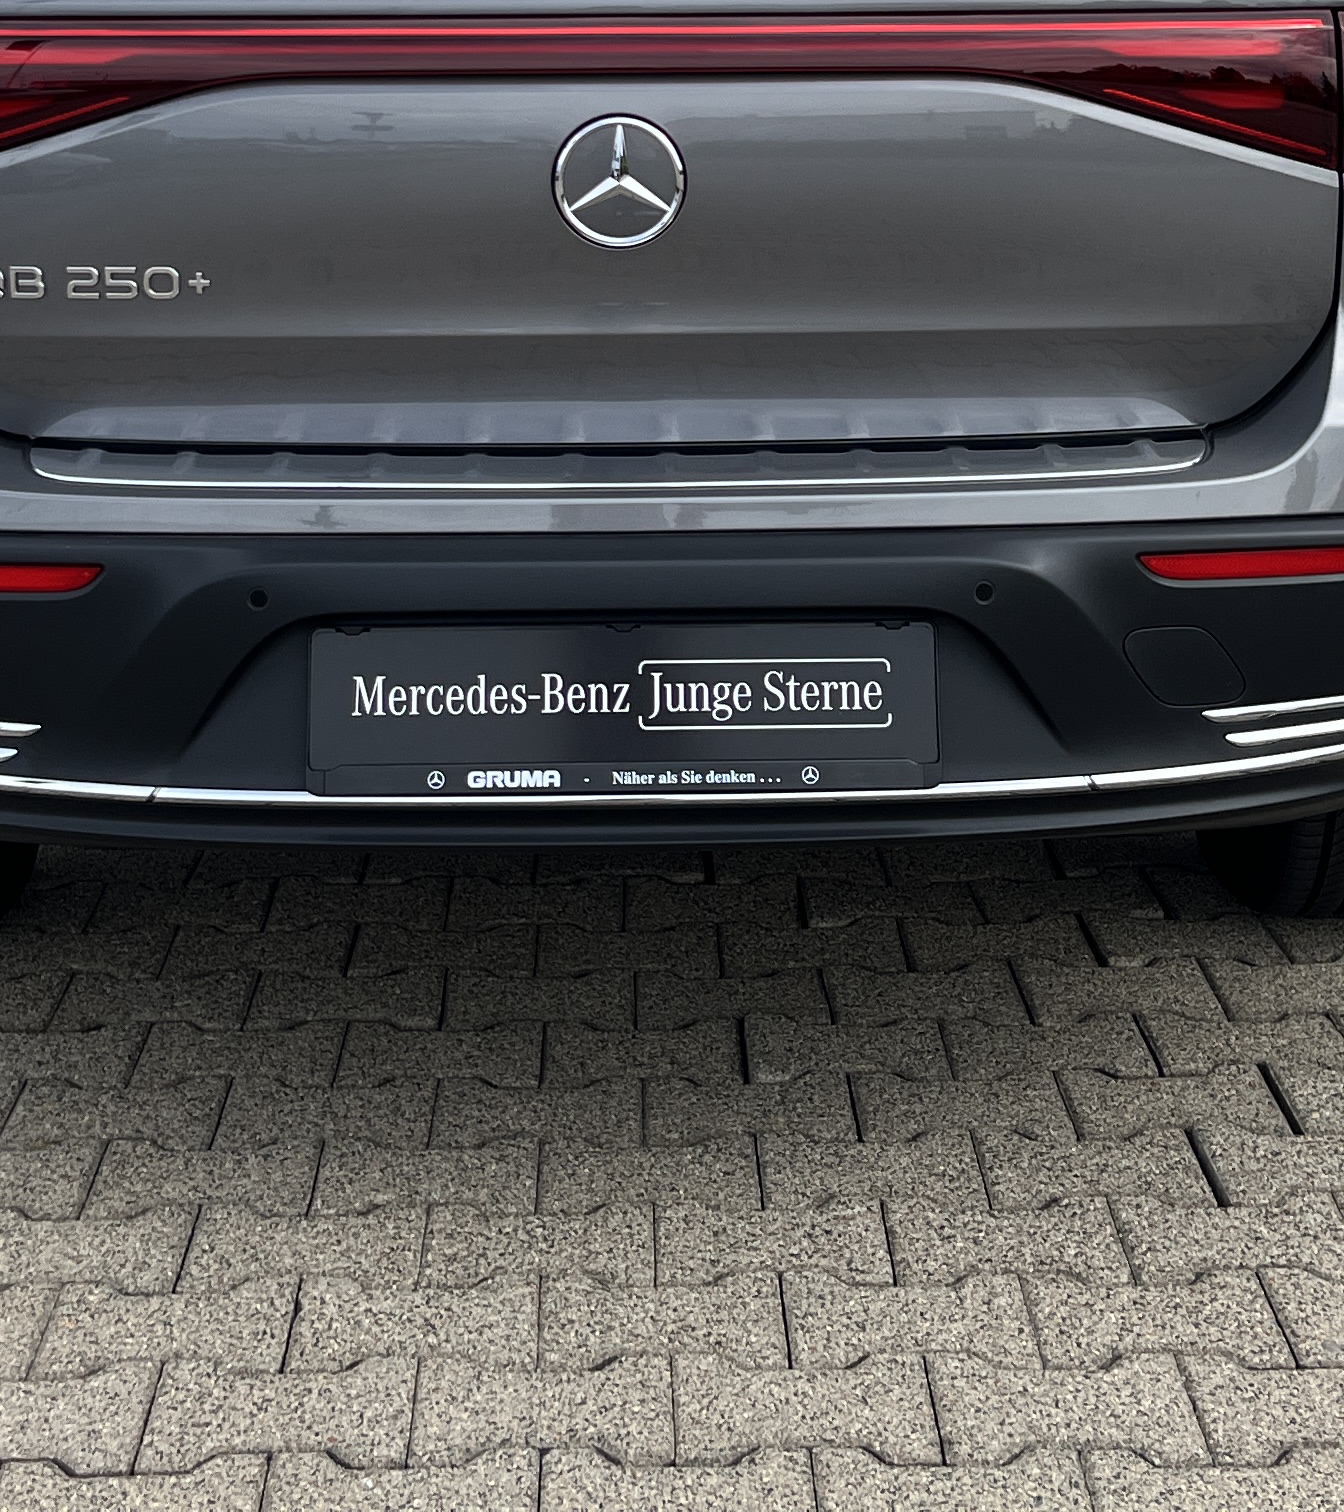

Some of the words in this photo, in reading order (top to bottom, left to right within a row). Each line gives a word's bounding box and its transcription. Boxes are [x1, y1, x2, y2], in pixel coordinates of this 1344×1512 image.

[66, 266, 210, 300] 250+
[351, 673, 631, 716] Mercedes-Benz
[648, 671, 752, 721] Junge
[763, 670, 883, 711] Sterne
[467, 770, 561, 789] GRUMA
[612, 771, 655, 785] Näher
[658, 770, 678, 785] als
[681, 770, 703, 785] Sie
[706, 769, 756, 784] denken
